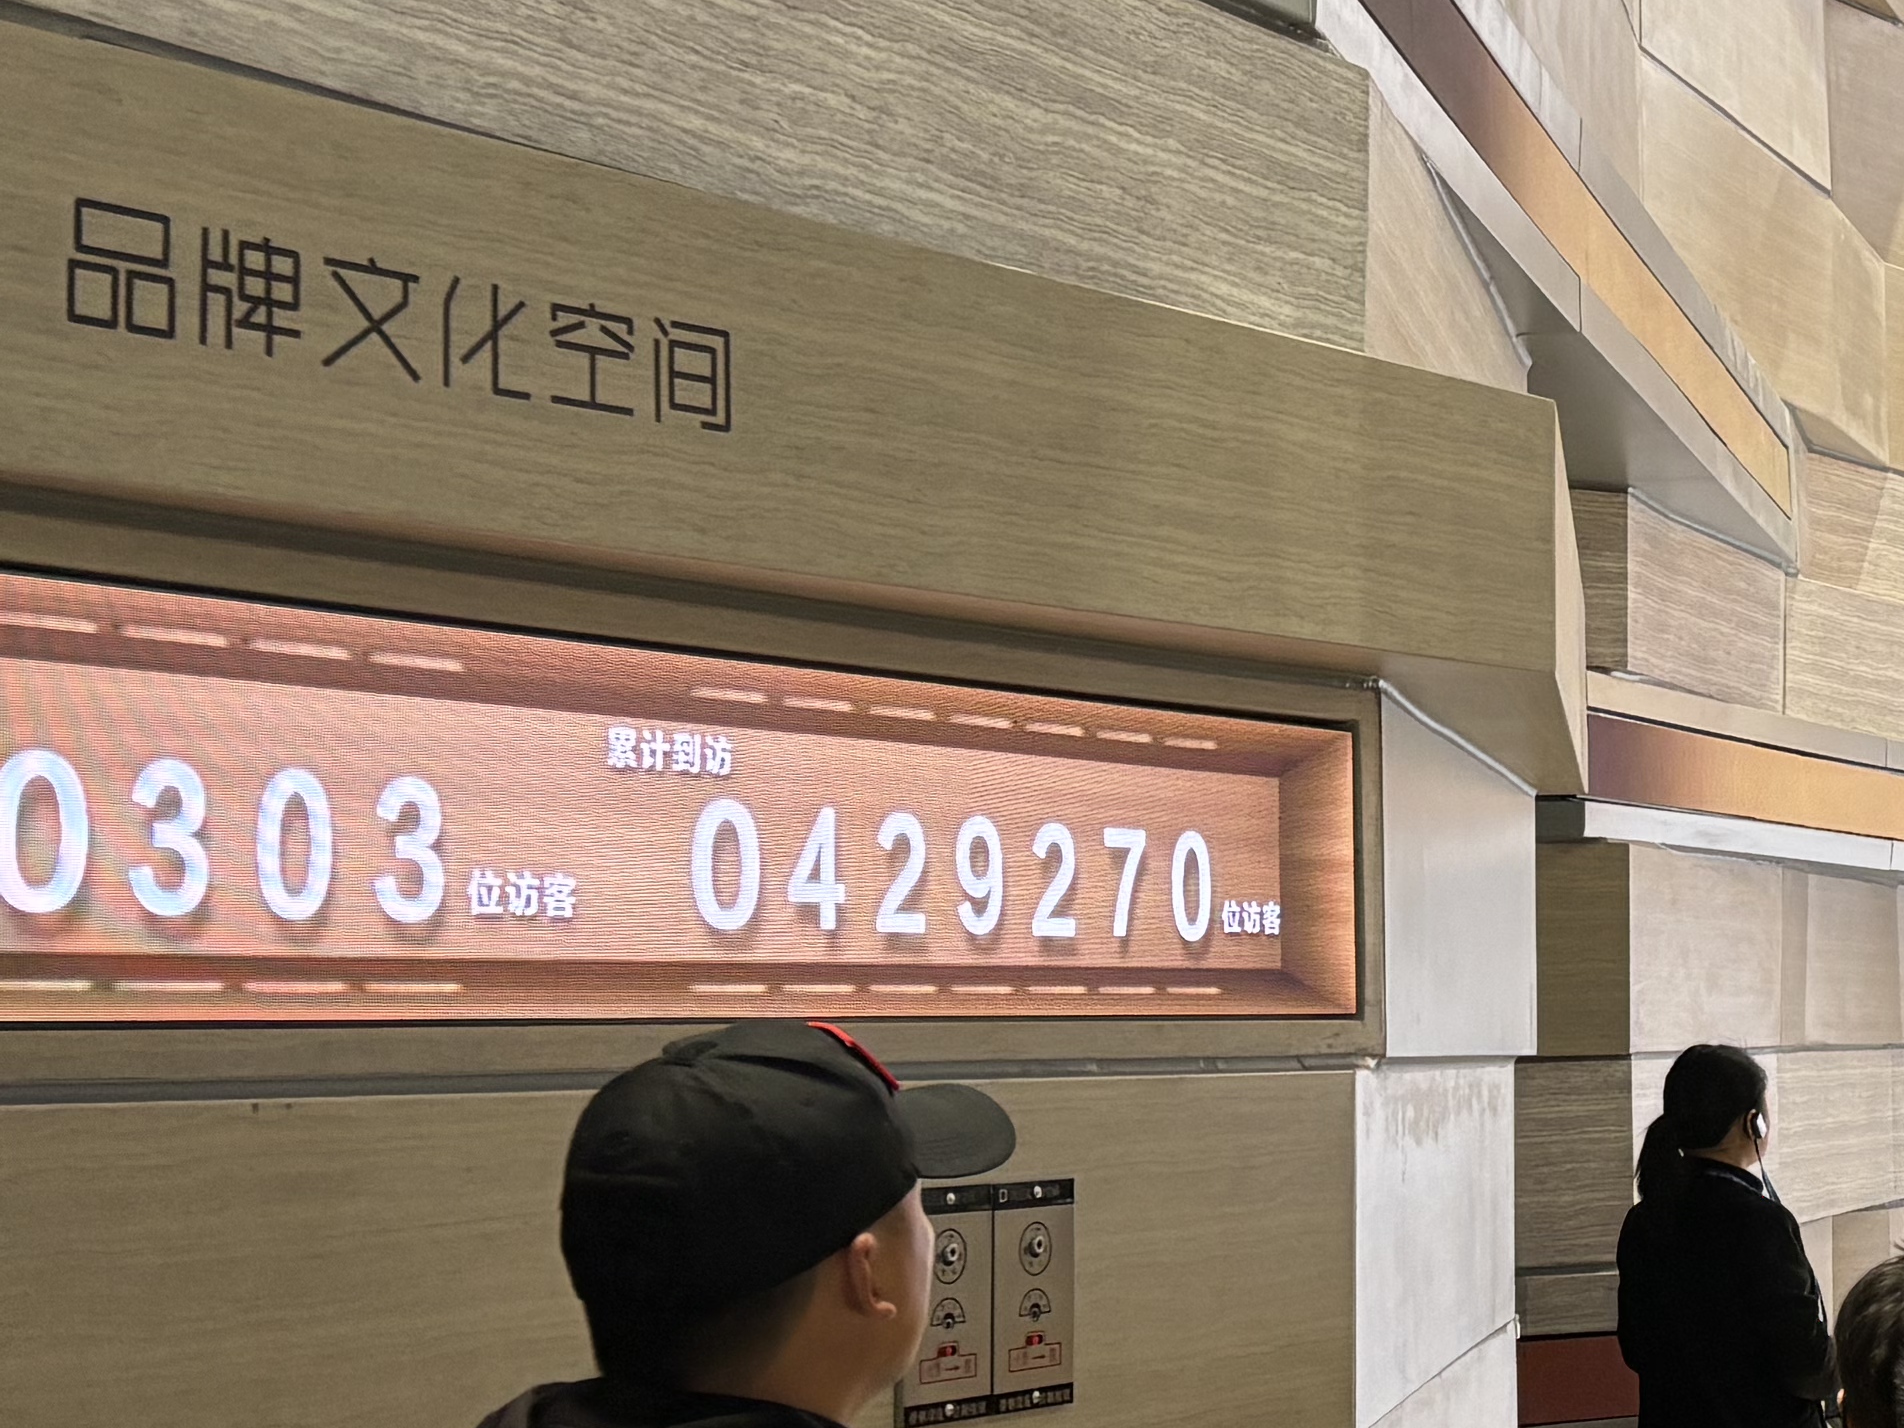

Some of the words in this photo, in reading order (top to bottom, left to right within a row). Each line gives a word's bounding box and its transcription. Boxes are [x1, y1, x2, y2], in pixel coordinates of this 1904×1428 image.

[66, 196, 732, 434] 品牌文化空间
[605, 723, 734, 776] 累计到访
[0, 747, 446, 924] 0303
[466, 867, 577, 919] 位访客
[689, 796, 1212, 943] 0429270
[1221, 899, 1282, 936] 位访客
